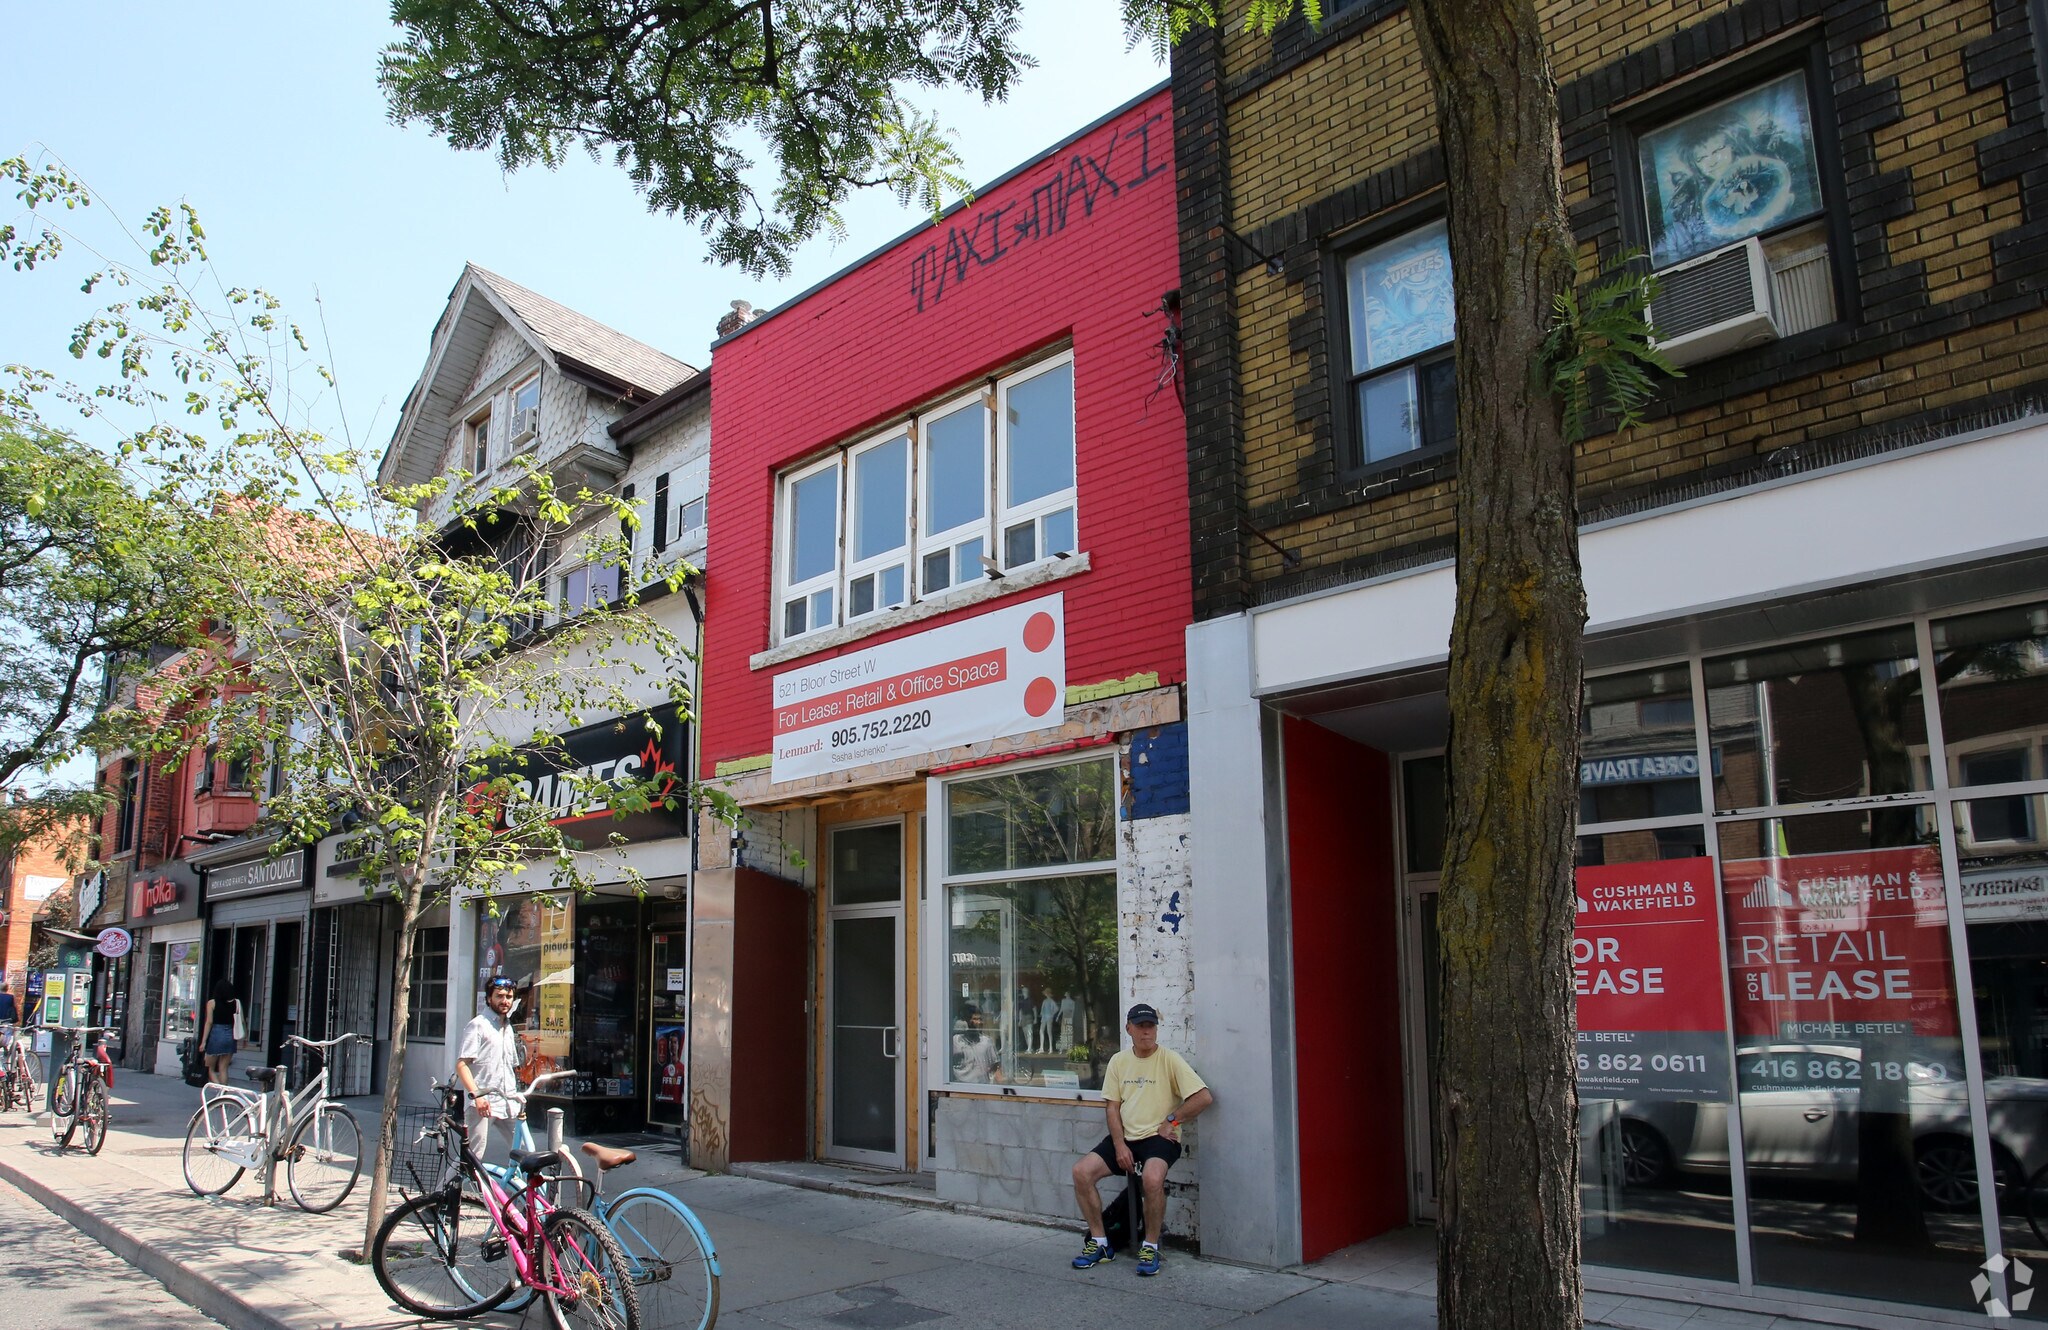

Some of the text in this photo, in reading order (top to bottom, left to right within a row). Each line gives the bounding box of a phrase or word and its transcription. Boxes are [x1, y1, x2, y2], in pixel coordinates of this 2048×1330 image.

[1379, 249, 1445, 290] TURTLES
[779, 658, 877, 698] 521 Bloor Street W
[779, 661, 999, 728] For Lease: Retail & Office Space
[778, 709, 931, 760] Lennard: 905.752.2220
[831, 752, 853, 763] Sasha
[505, 754, 641, 828] GAMES
[247, 858, 296, 885] SANTOUKA
[1798, 871, 1922, 891] CUSHMAN &
[1593, 881, 1694, 899] CUSHMAN &
[1799, 886, 1925, 905] WAKEFIELD
[1594, 895, 1696, 911] WAKEFIELD
[1573, 938, 1620, 963] OR
[1742, 931, 1906, 964] RETAIL
[1575, 967, 1665, 994] EASE
[1747, 969, 1912, 1001] FOR LEASE
[545, 1017, 564, 1028] SAVE
[1787, 1023, 1851, 1034] MICHAEL
[1598, 1053, 1642, 1071] 862
[1651, 1054, 1706, 1072] 0611
[1751, 1059, 1798, 1078] 416
[1807, 1060, 1862, 1080] 862
[1578, 1075, 1640, 1084] nwakefield.com
[1751, 1084, 1860, 1095] cushmanwakefield.com
